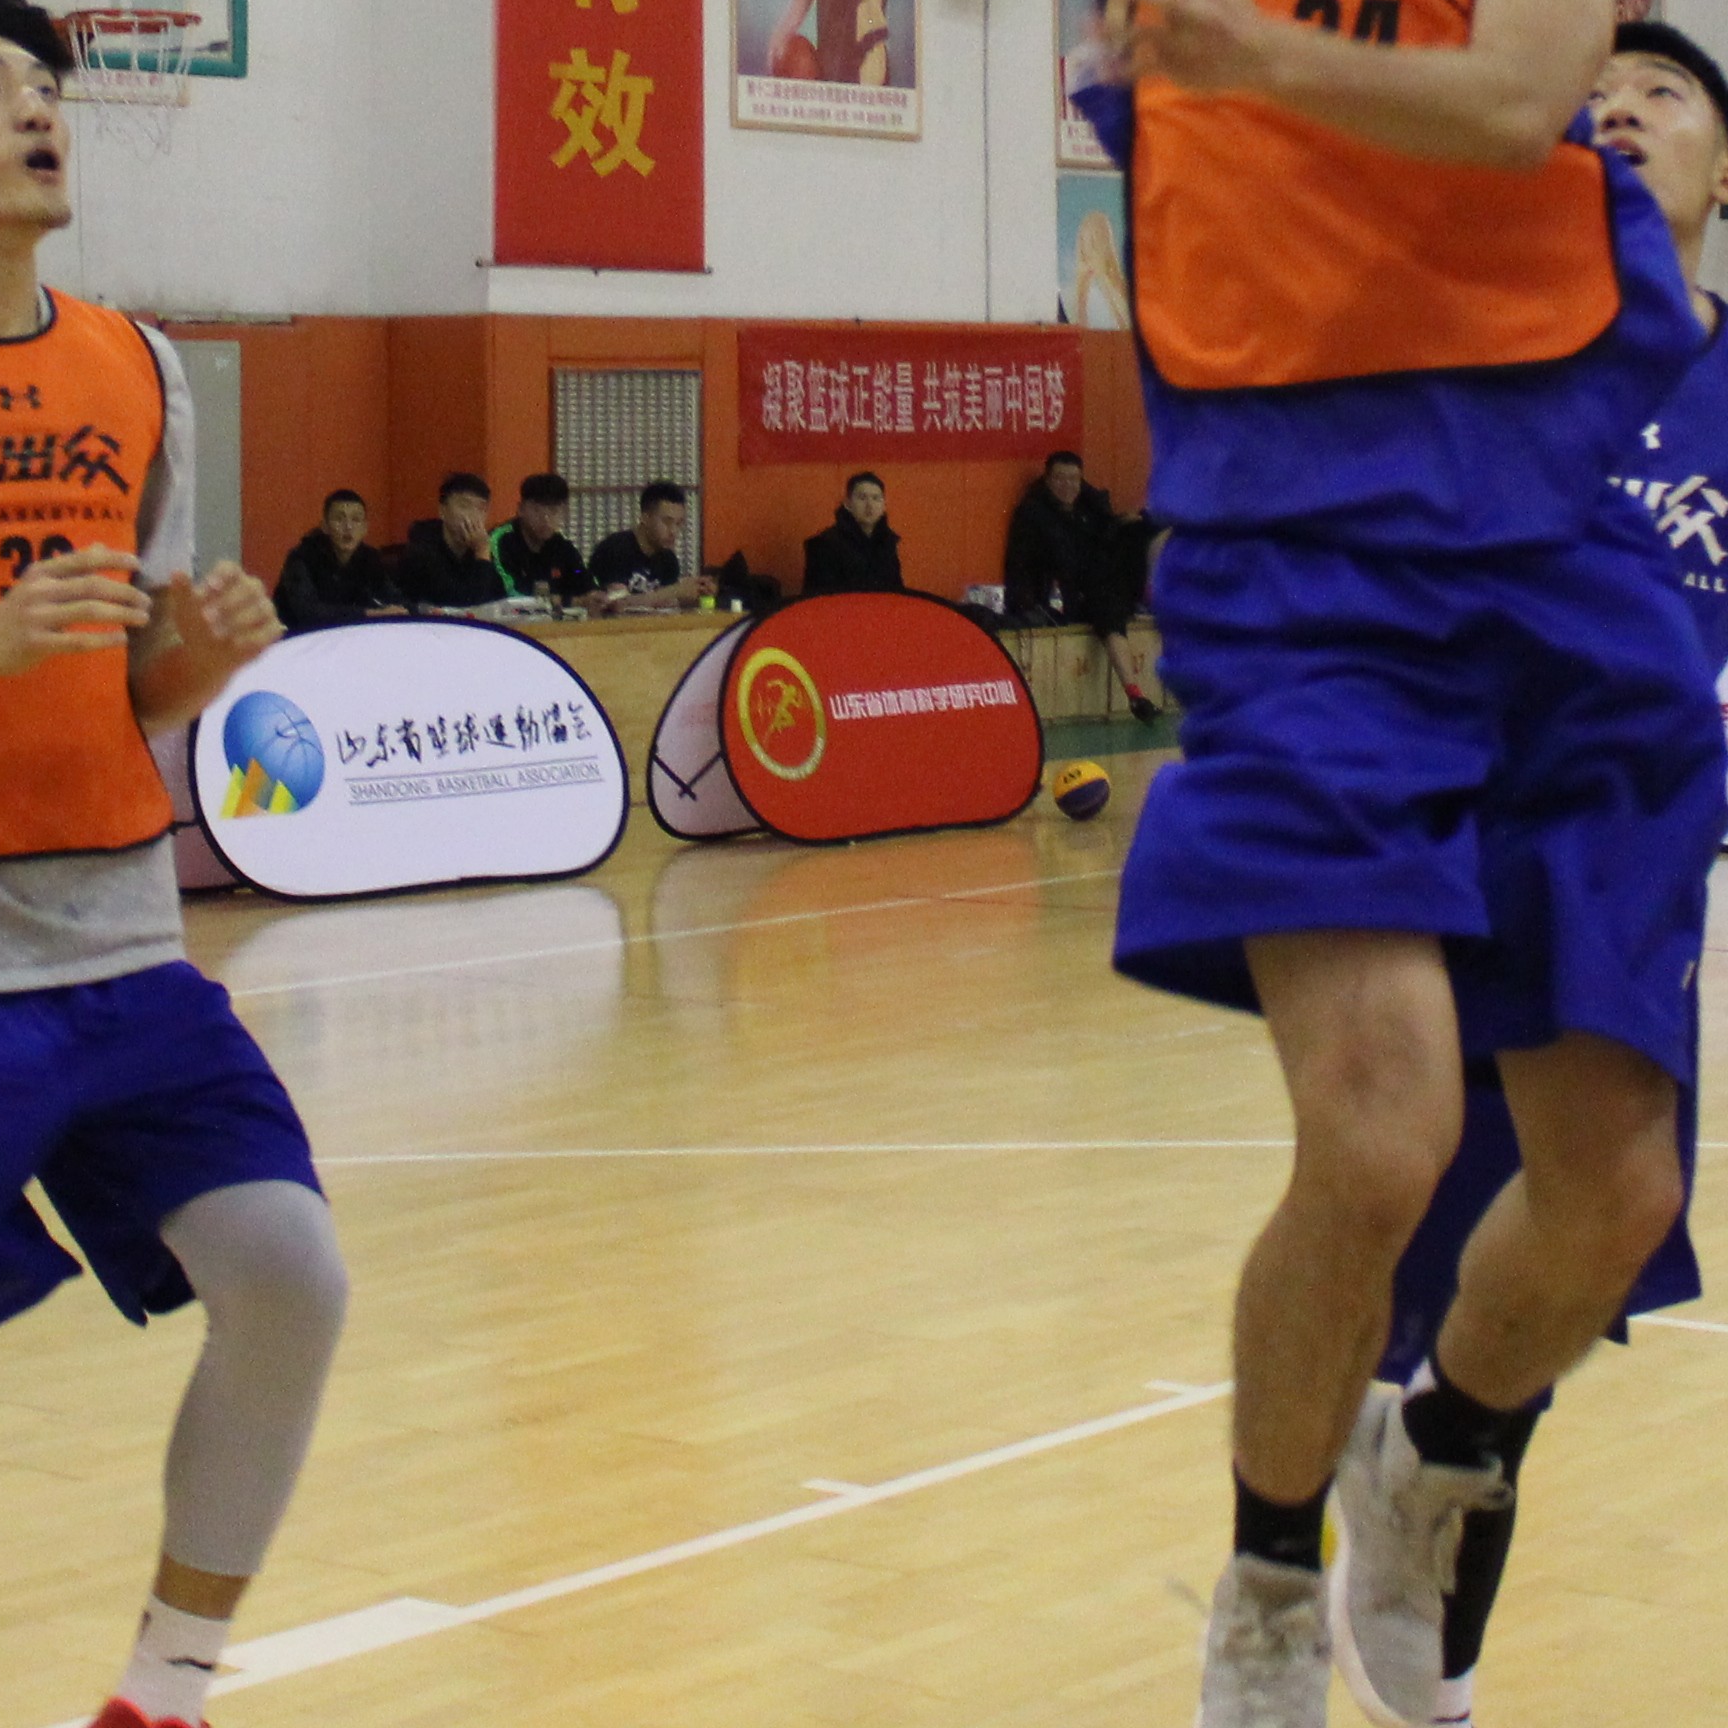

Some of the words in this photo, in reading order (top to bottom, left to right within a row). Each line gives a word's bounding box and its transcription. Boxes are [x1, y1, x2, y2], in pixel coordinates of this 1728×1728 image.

[761, 360, 915, 434] 凝聚篮球正能量
[922, 361, 1066, 434] 共筑美丽中国梦
[828, 679, 1019, 721] 山东省体育科学研究中心
[349, 779, 431, 801] SHANDONG
[437, 772, 512, 794] BASKETBALL
[517, 761, 601, 787] ASSOCIATION
